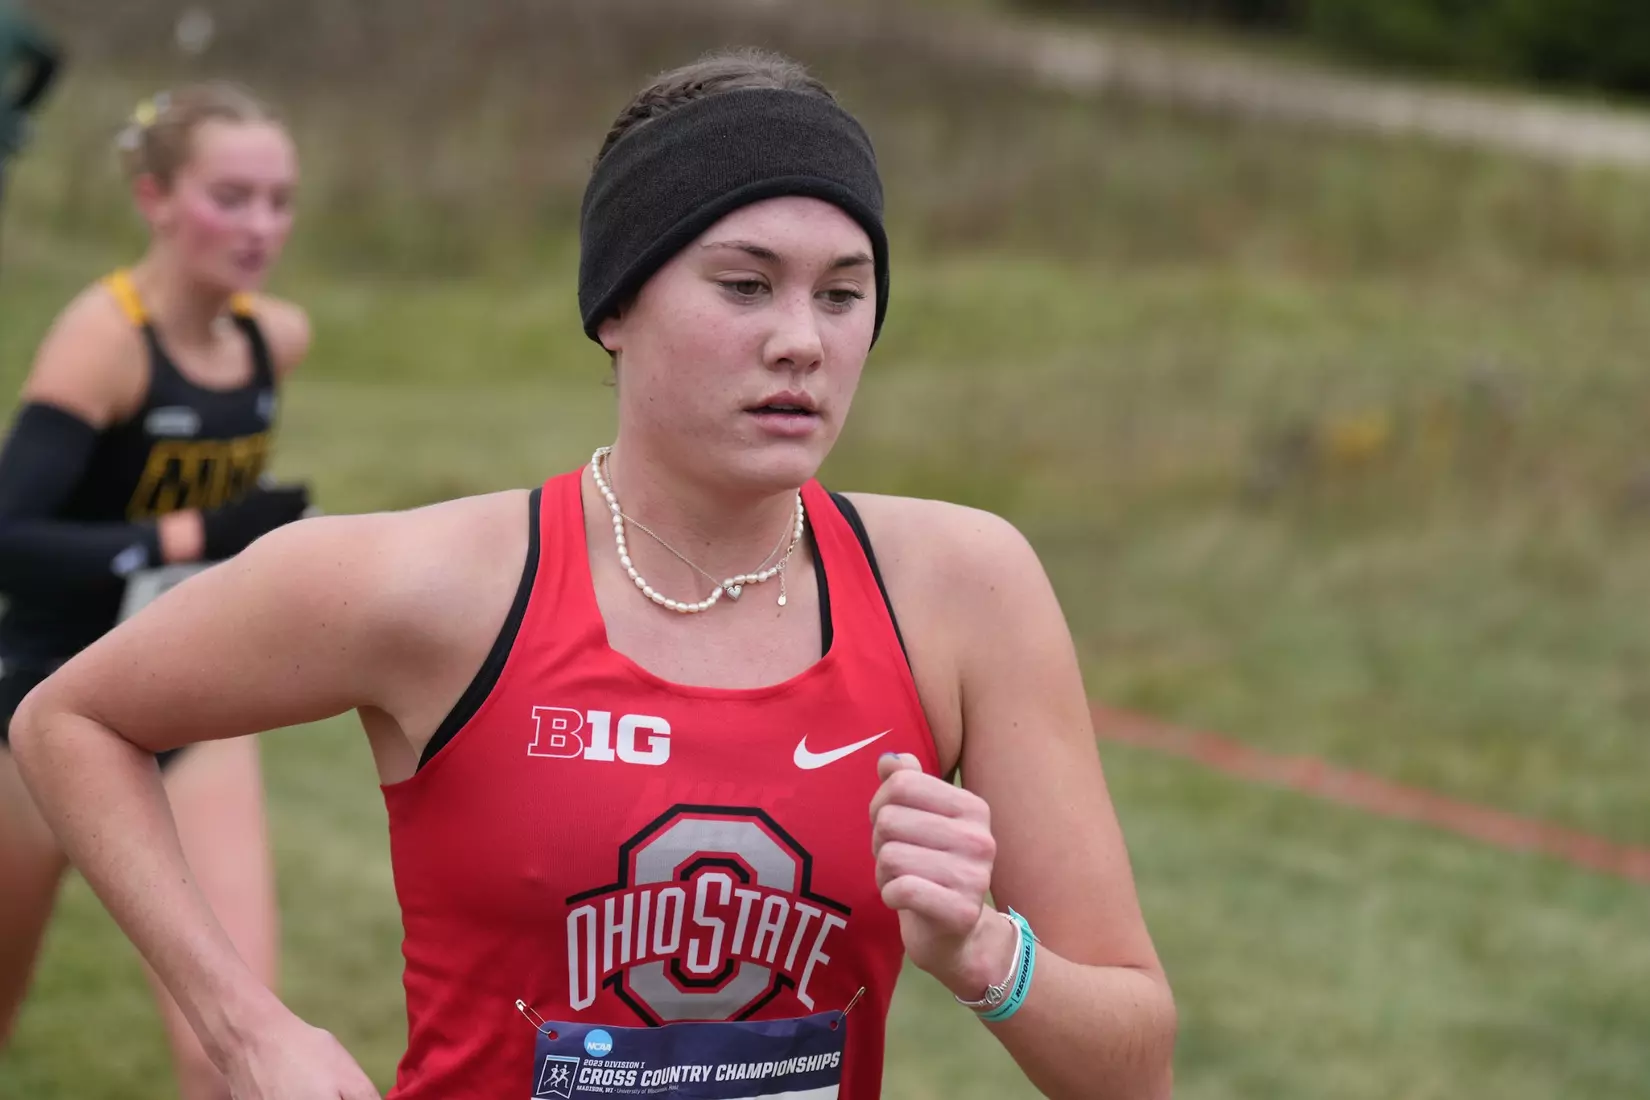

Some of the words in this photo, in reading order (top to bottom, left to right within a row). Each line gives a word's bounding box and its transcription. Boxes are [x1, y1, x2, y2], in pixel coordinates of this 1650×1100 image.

[566, 886, 686, 1012] OHIO
[686, 872, 848, 1012] STATE
[1015, 944, 1031, 998] REGIONAL
[583, 1059, 603, 1067] 2023
[604, 1060, 639, 1069] DIVISION
[586, 1042, 612, 1052] NCAA
[579, 1067, 637, 1087] CROSS
[640, 1065, 713, 1087] COUNTRY
[715, 1051, 841, 1081] CHAMPIONSHIPS
